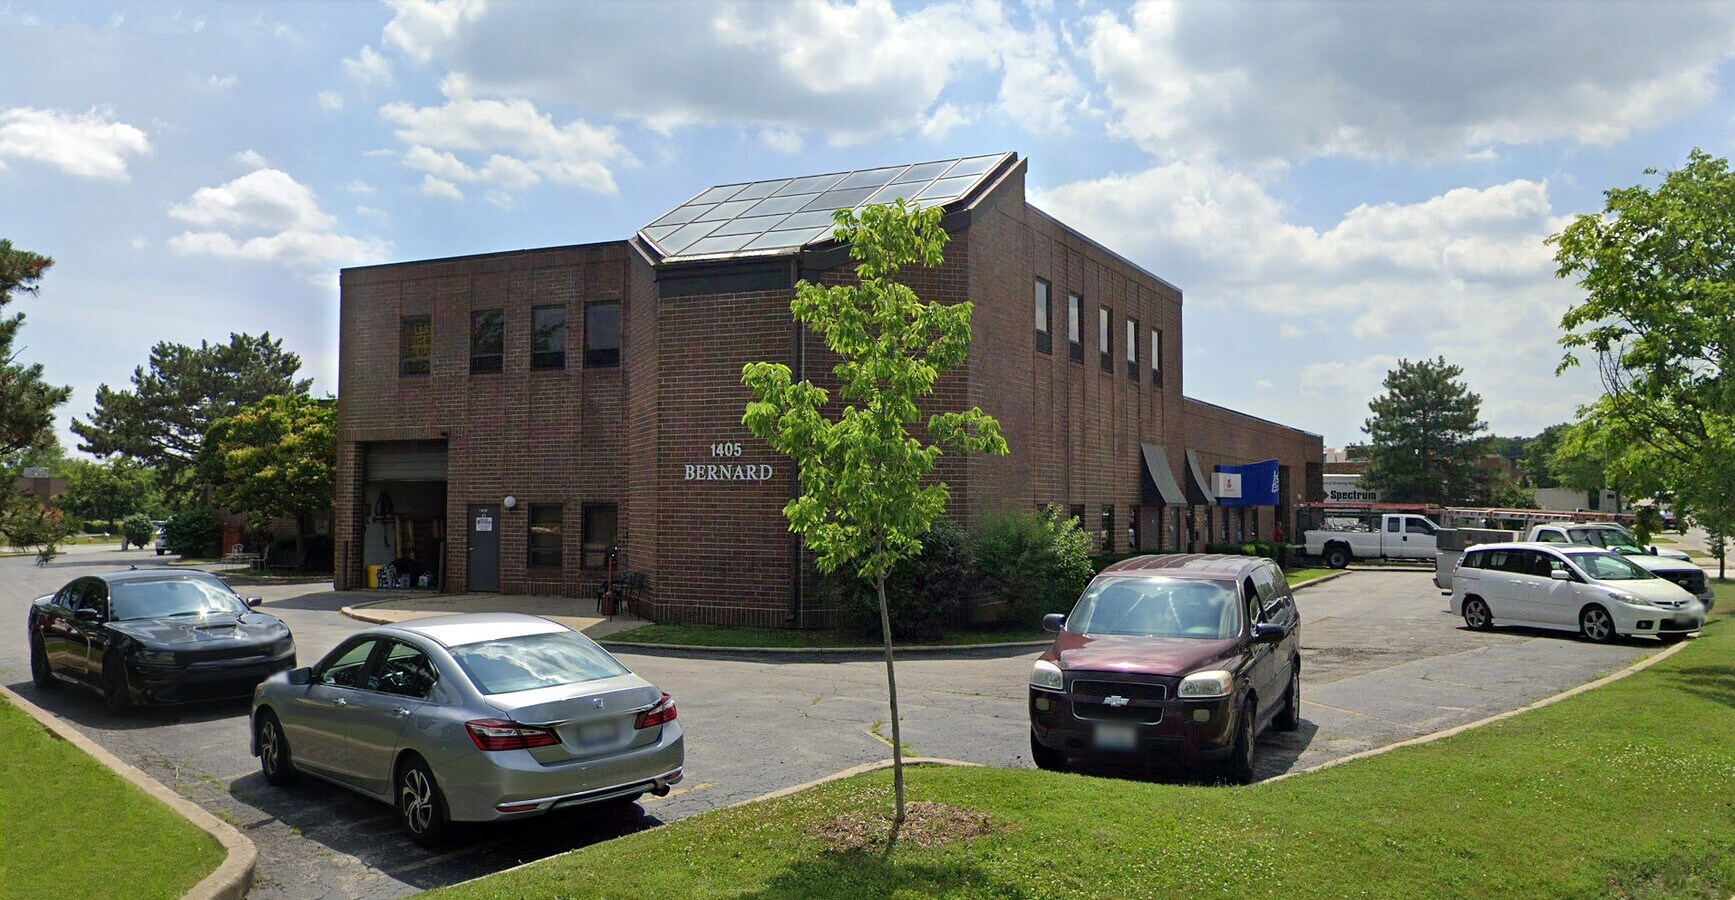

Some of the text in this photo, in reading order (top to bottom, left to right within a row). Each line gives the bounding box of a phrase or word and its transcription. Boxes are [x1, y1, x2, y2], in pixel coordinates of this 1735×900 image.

[710, 442, 742, 457] 1405
[684, 464, 773, 480] BERNARD
[1330, 490, 1377, 501] Spectrum
